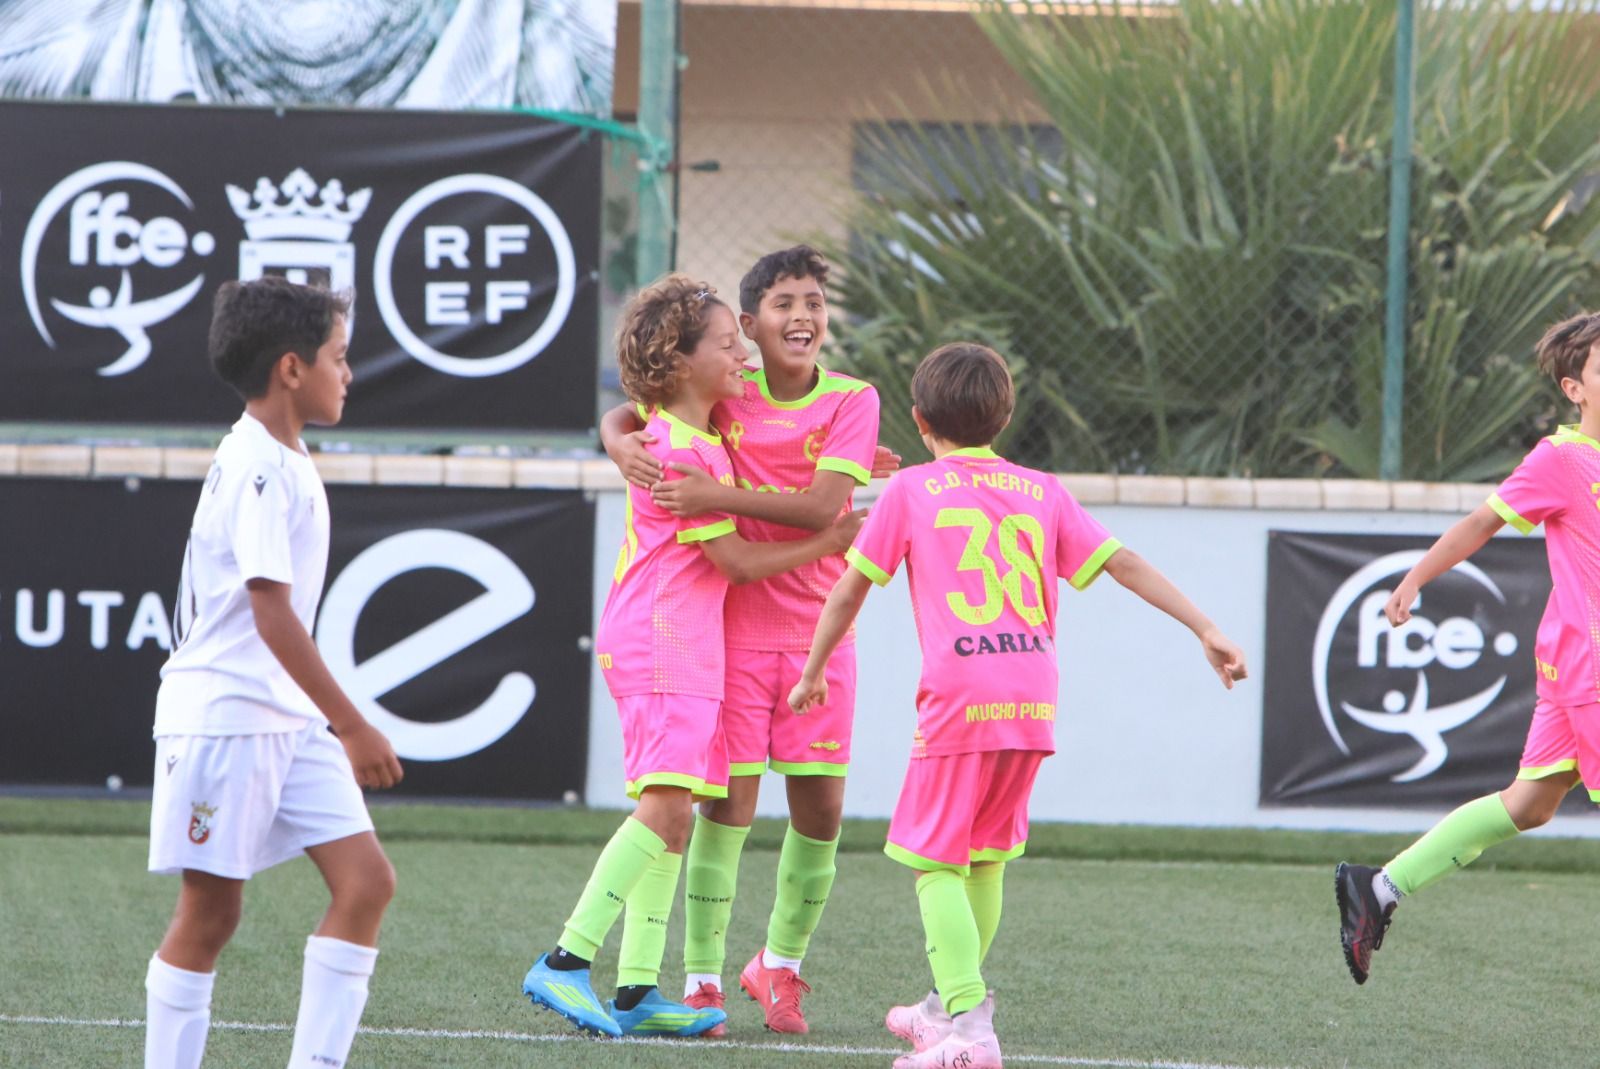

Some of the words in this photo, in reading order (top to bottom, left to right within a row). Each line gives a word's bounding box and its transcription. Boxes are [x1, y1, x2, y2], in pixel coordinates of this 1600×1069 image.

[971, 472, 1044, 501] PUERTO
[934, 507, 1047, 627] 38
[965, 702, 1016, 723] MUCHO
